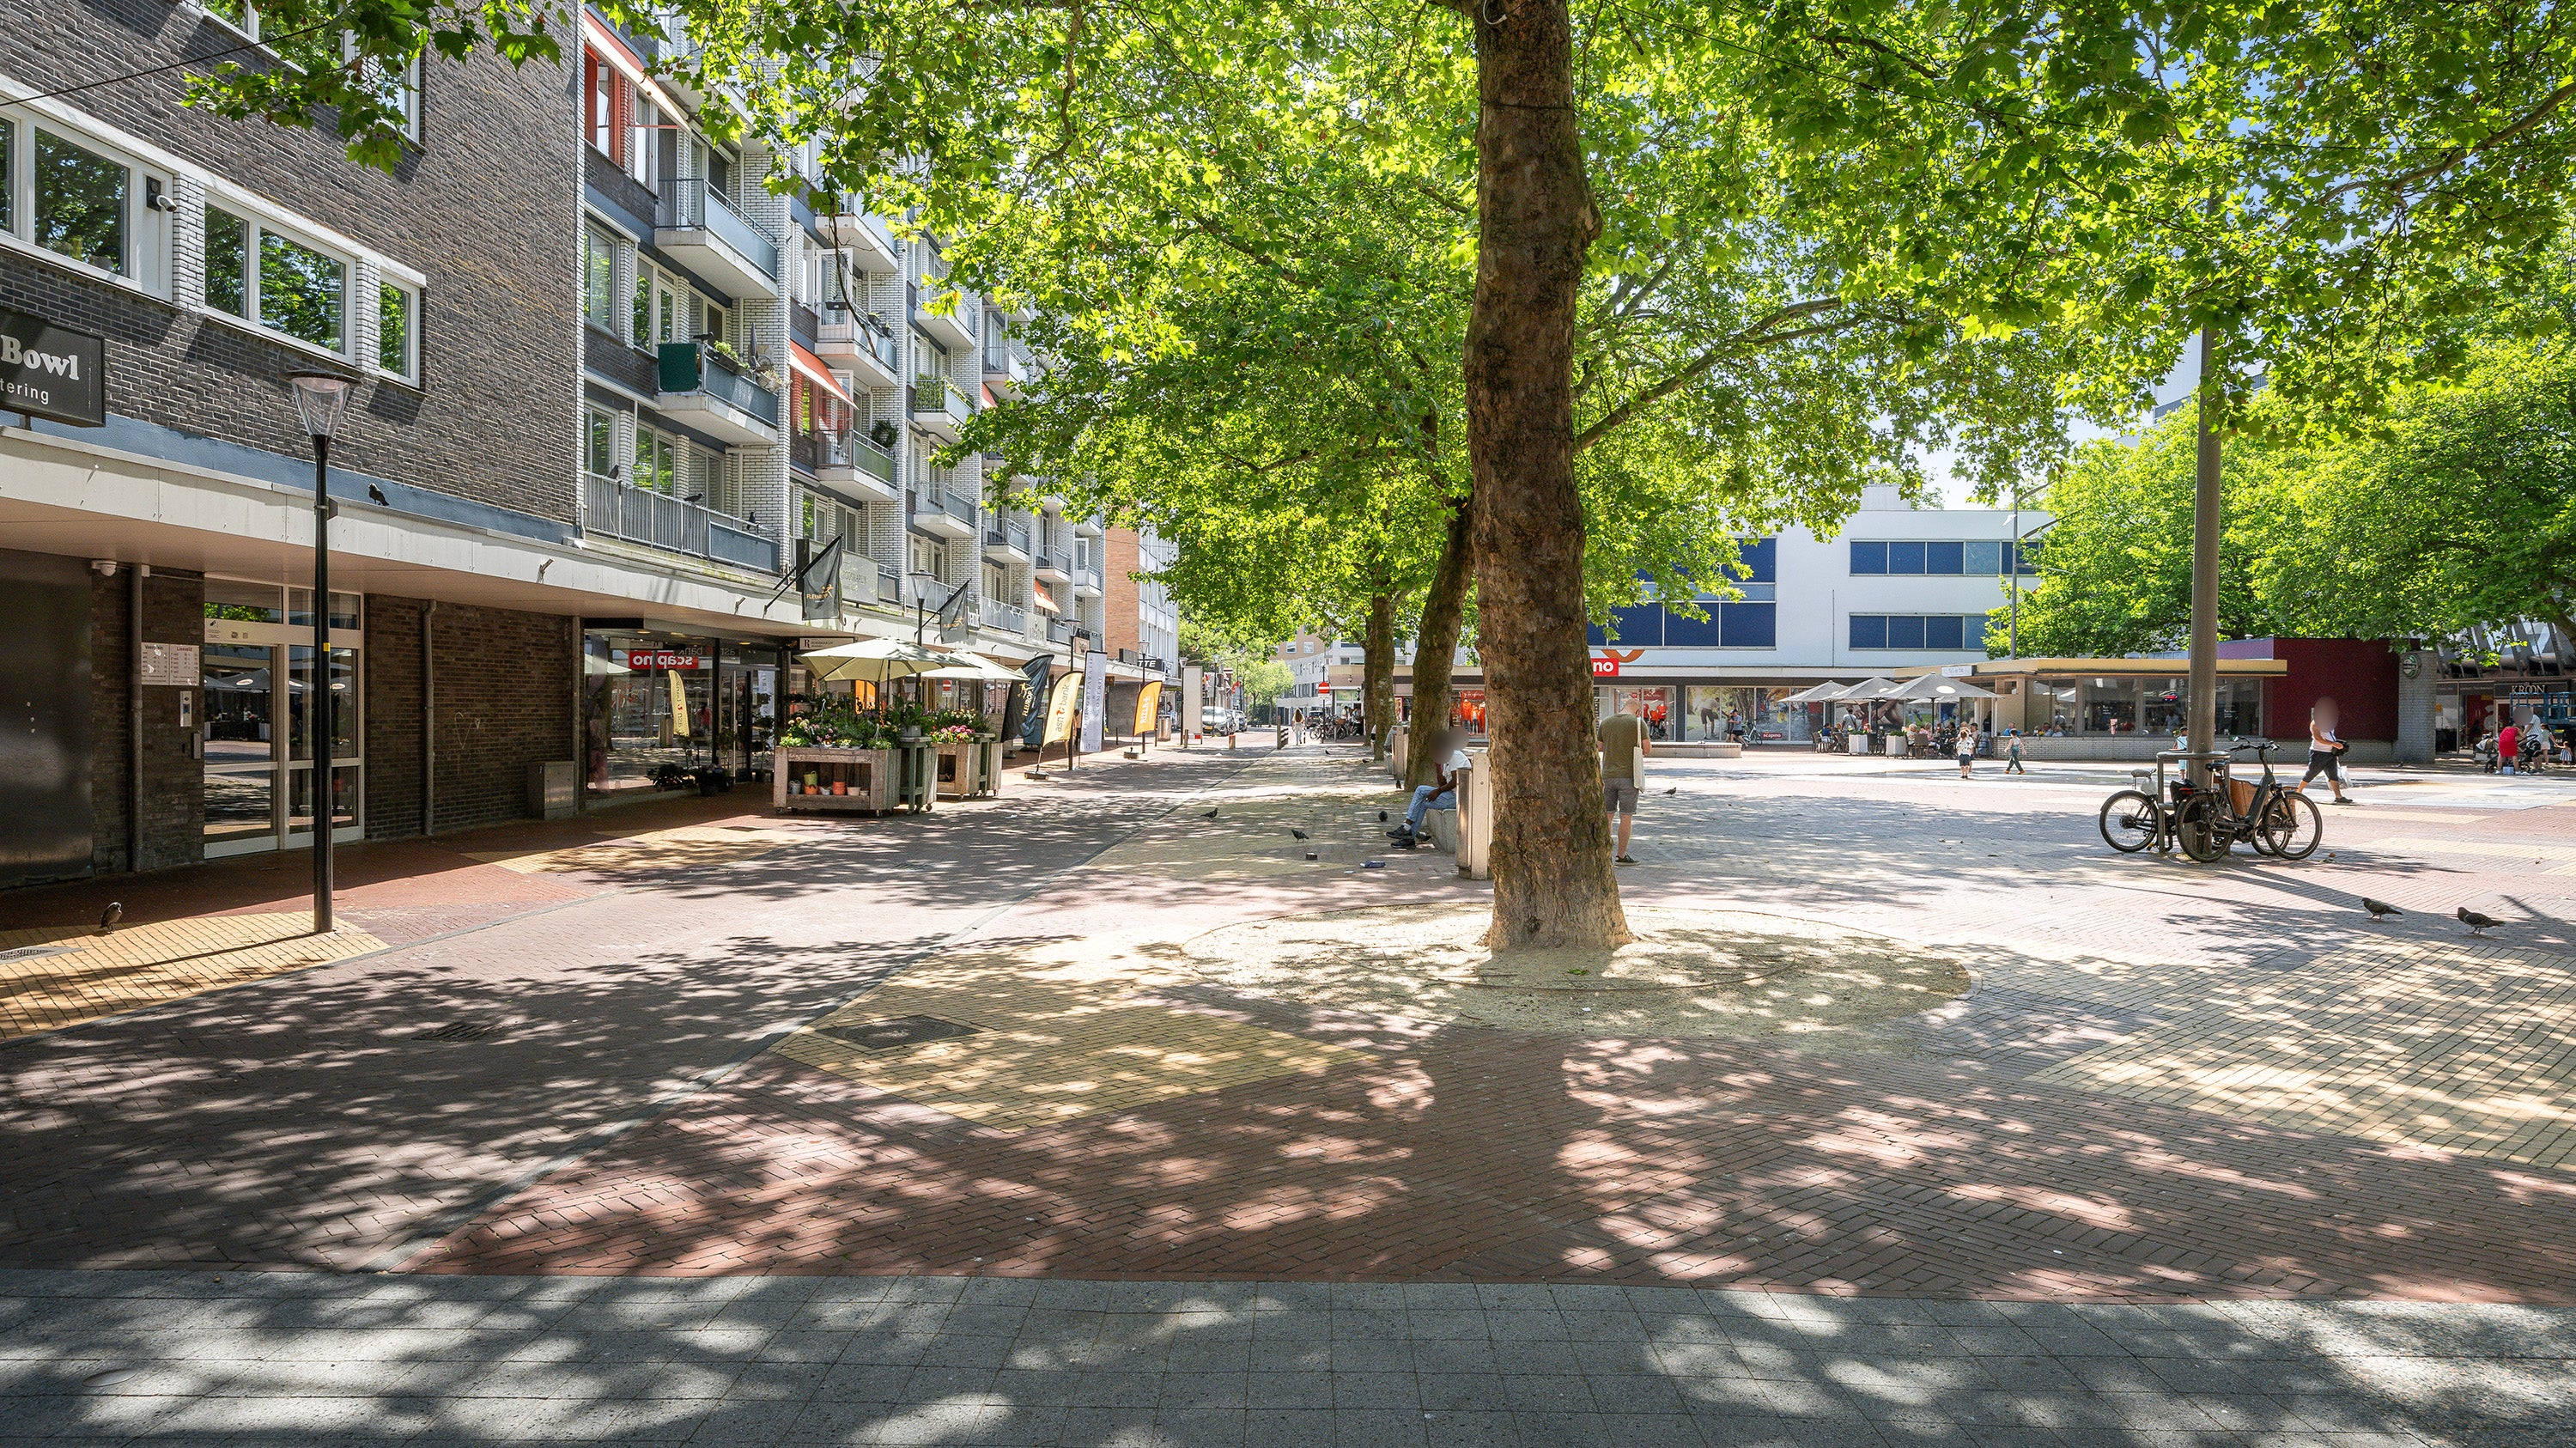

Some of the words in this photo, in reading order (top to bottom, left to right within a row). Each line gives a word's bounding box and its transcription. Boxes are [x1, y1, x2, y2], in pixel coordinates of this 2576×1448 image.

[1, 334, 80, 380] Bowl
[1022, 691, 1034, 717] FLEUROP
[2511, 684, 2545, 694] KROON
[1055, 716, 1064, 733] asn
[1060, 684, 1071, 708] bank
